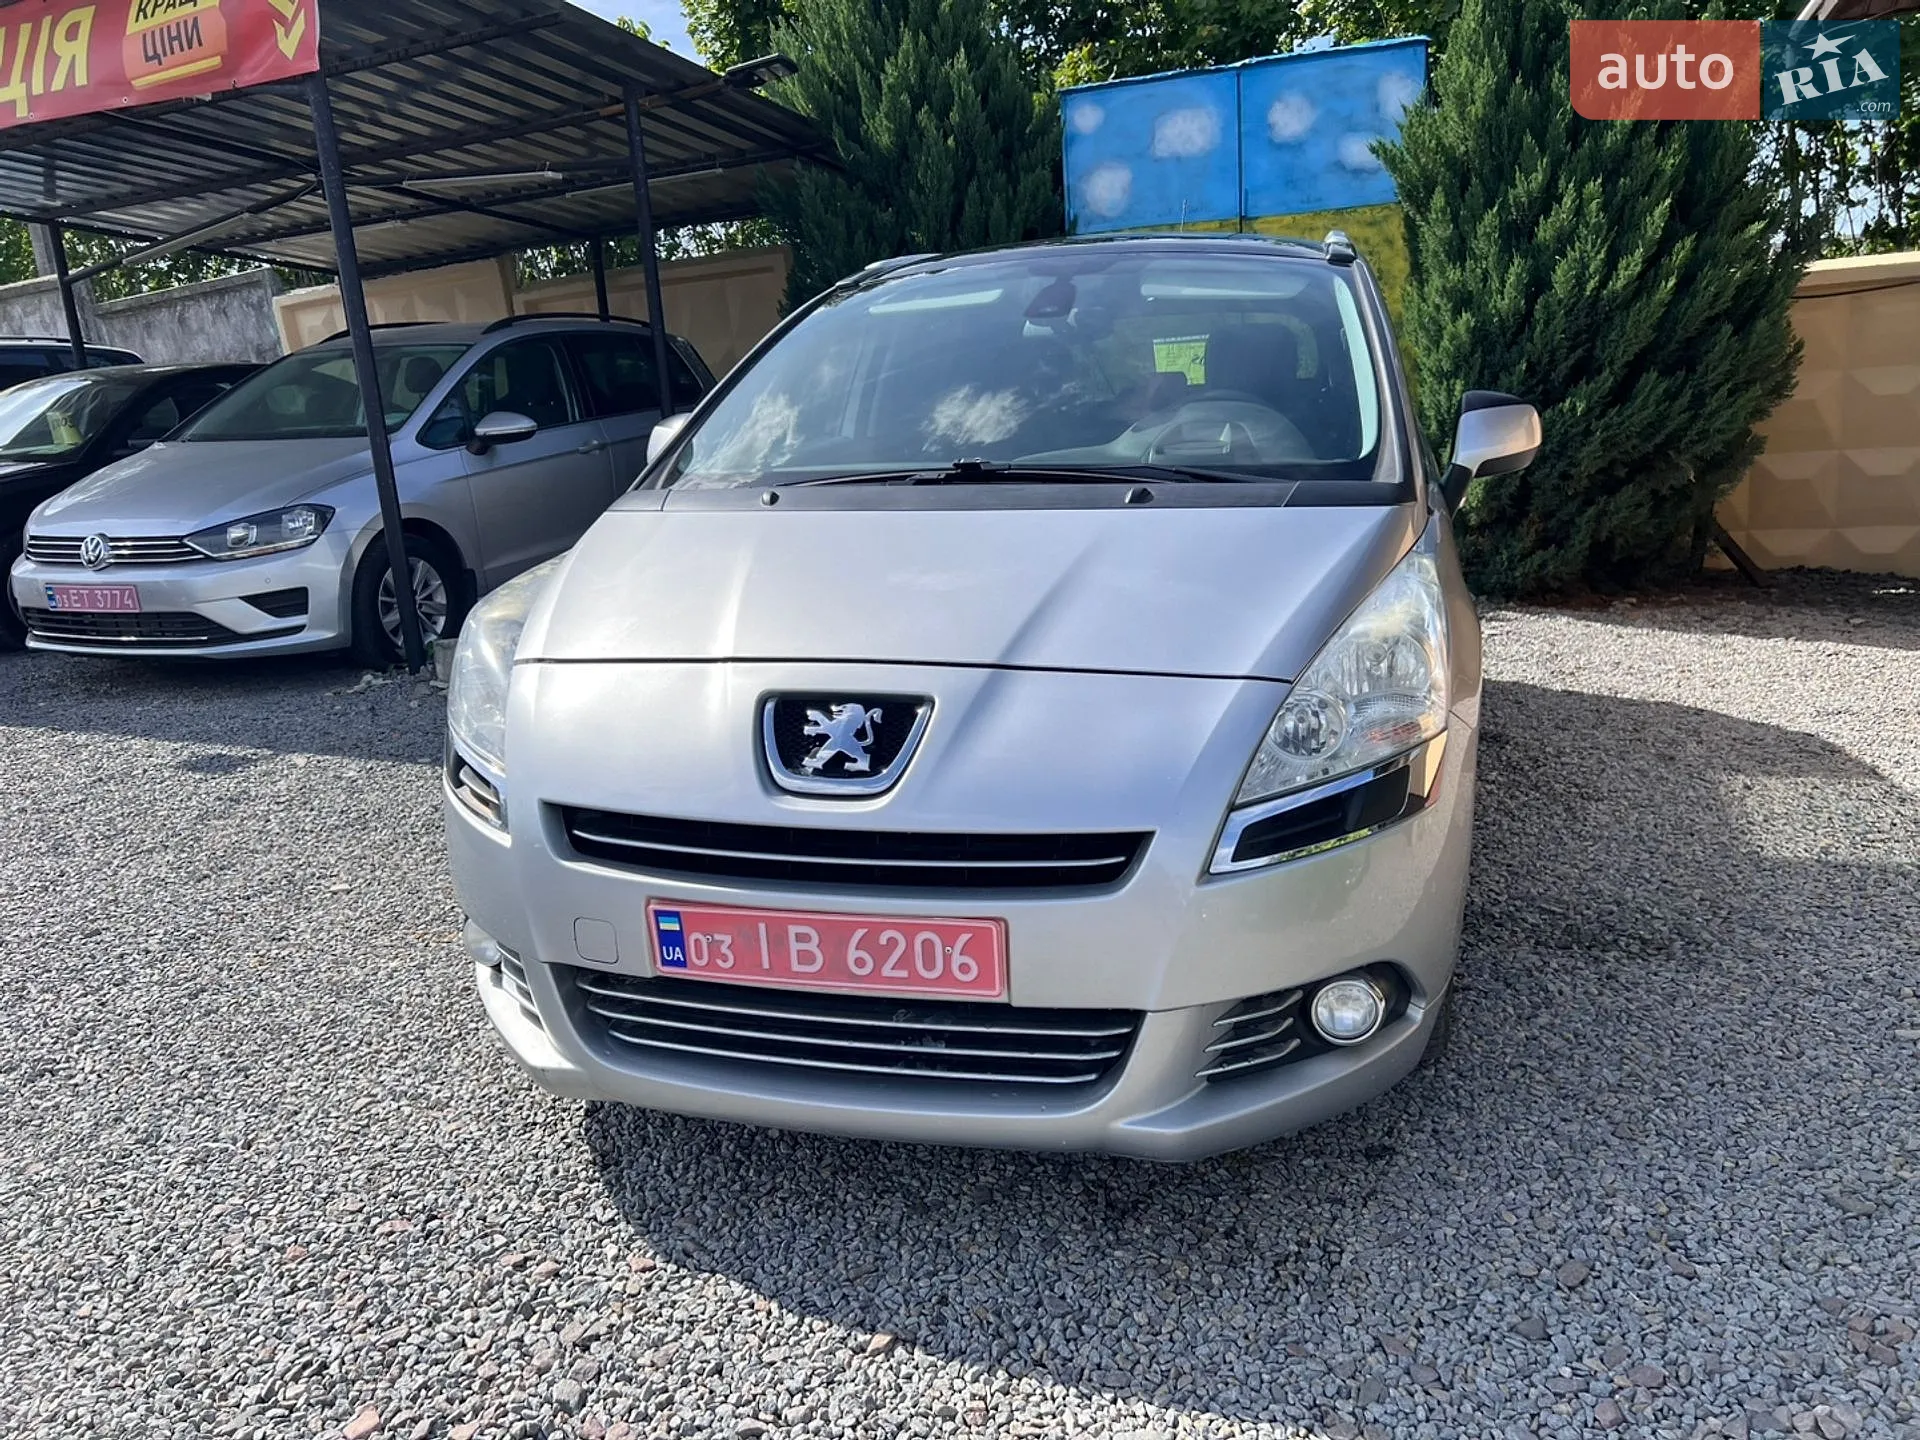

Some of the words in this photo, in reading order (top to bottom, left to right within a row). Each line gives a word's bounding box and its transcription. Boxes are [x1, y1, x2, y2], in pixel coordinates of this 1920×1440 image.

[142, 16, 203, 66] ЦІНИ
[69, 589, 90, 608] ET
[94, 589, 134, 609] 3774
[662, 946, 684, 962] UA
[689, 931, 735, 969] 03
[846, 928, 979, 982] 6206
